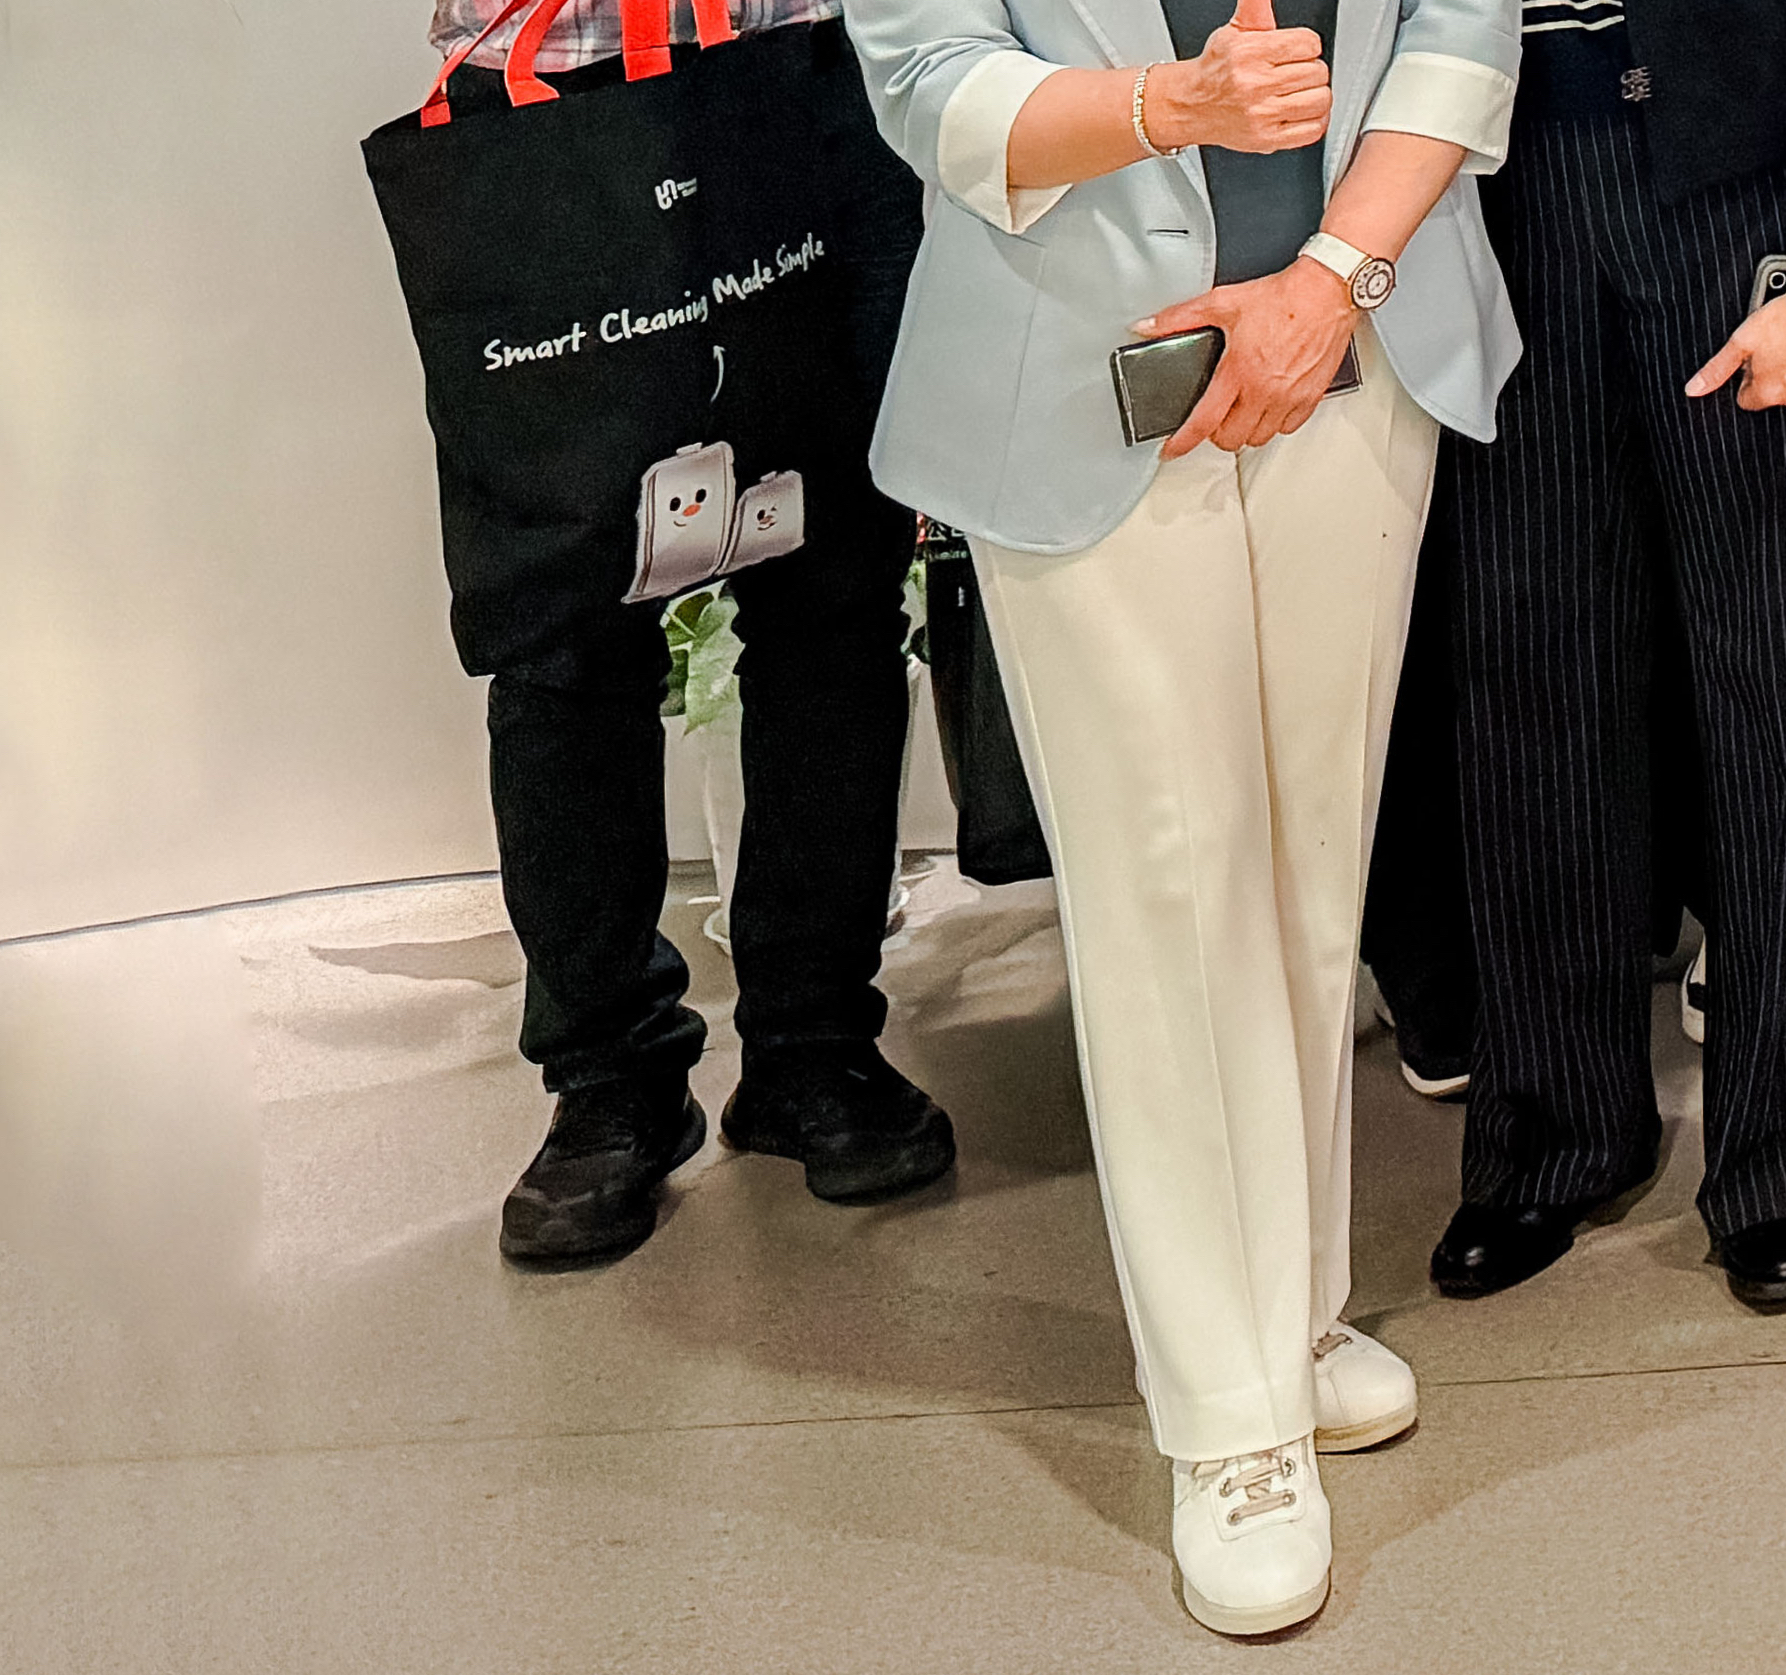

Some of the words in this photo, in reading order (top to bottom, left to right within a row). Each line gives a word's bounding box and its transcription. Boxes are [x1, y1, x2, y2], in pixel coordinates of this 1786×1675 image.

[484, 323, 587, 371] Smart
[712, 259, 775, 304] Made
[776, 232, 825, 277] Simple
